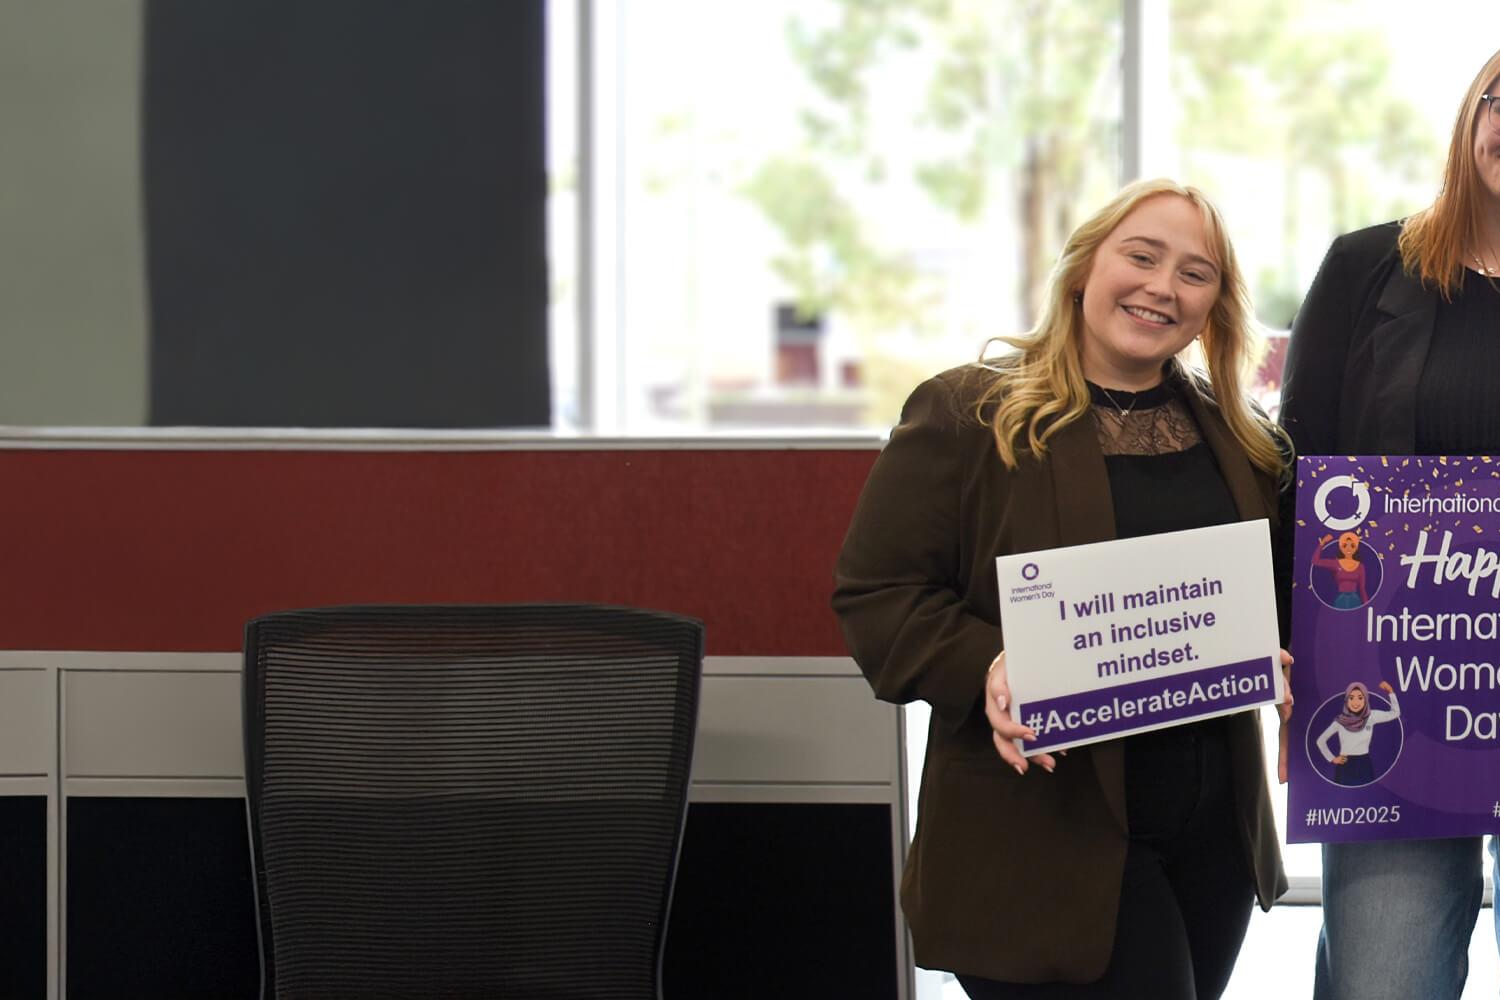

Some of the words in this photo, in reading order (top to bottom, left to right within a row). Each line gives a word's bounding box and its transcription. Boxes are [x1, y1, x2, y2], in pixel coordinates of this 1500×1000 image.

[1011, 582, 1053, 595] International
[1041, 591, 1056, 599] Day
[1059, 600, 1066, 620] I
[1073, 593, 1116, 618] will
[1122, 577, 1223, 610] maintain
[1073, 630, 1103, 650] an
[1111, 611, 1216, 644] inclusive
[1097, 643, 1200, 678] mindset.
[1026, 673, 1270, 737] #AccelerateAction
[1306, 805, 1401, 826] #IWD2025
